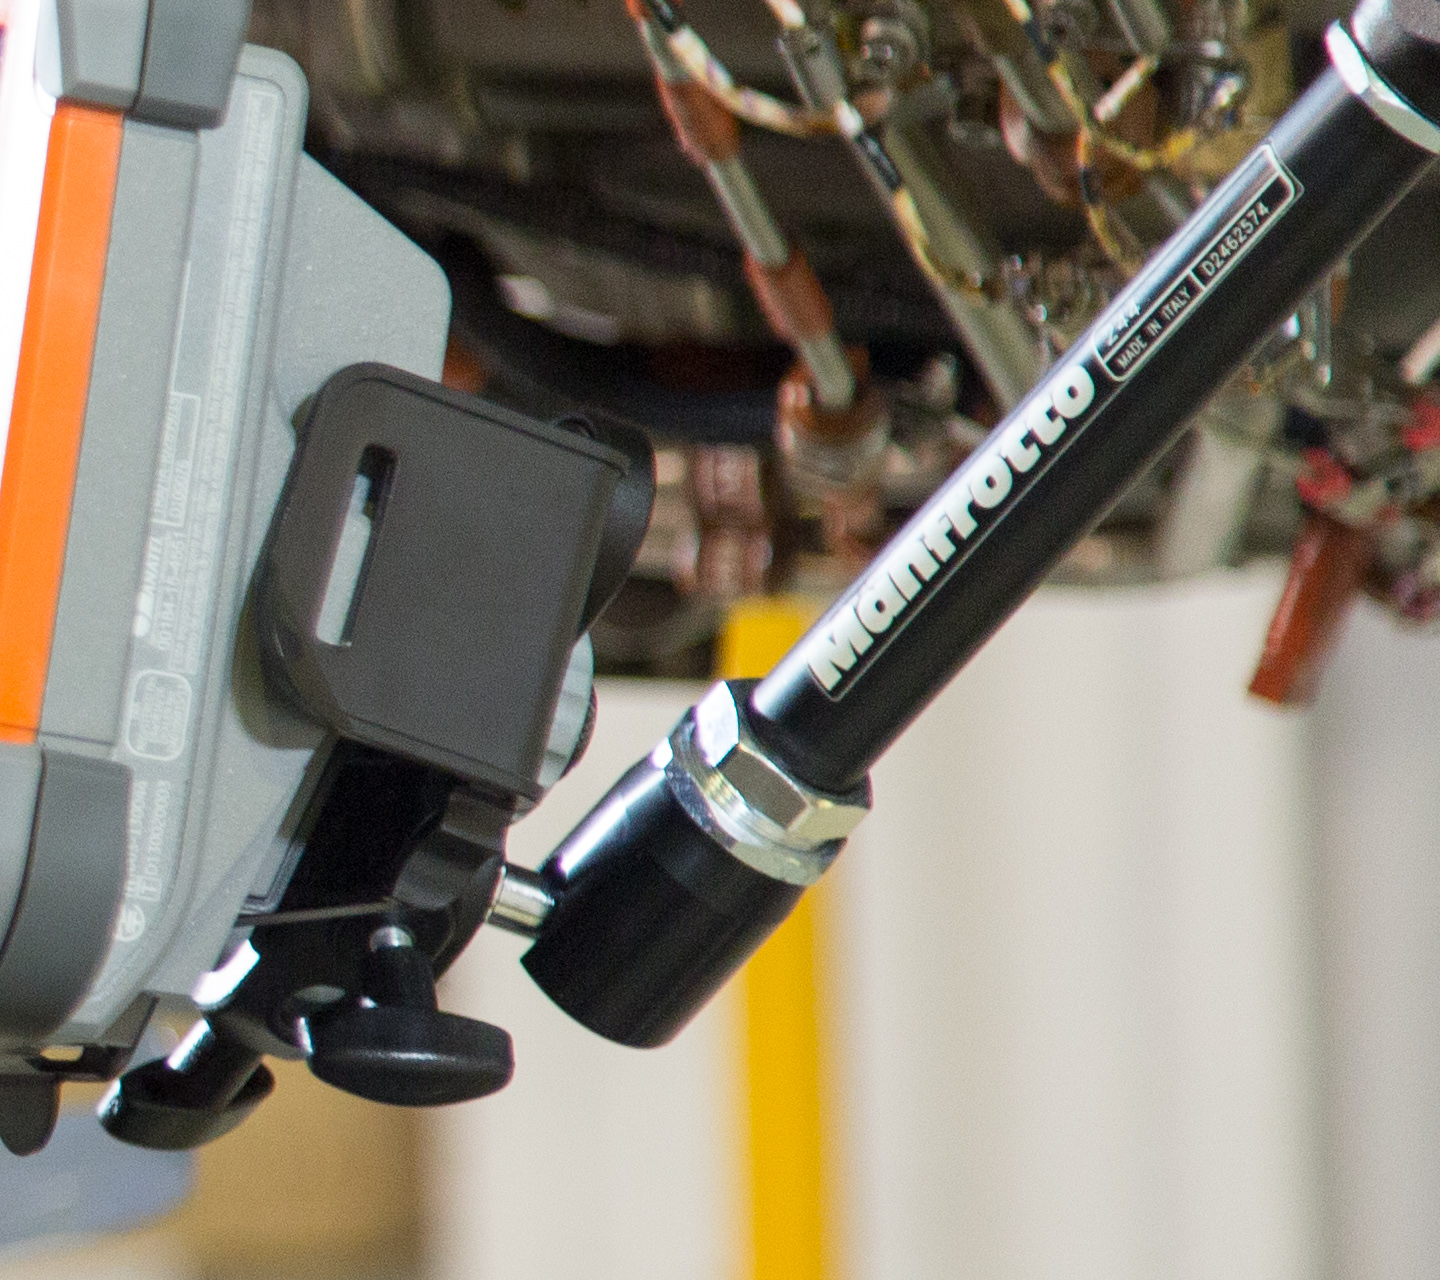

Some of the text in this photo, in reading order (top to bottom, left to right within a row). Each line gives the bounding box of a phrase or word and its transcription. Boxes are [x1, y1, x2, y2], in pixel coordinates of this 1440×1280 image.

[1201, 201, 1270, 277] D2462574
[1105, 299, 1141, 346] 244
[1116, 286, 1192, 369] MADE IN ITALY
[807, 364, 1097, 691] Manfrotto
